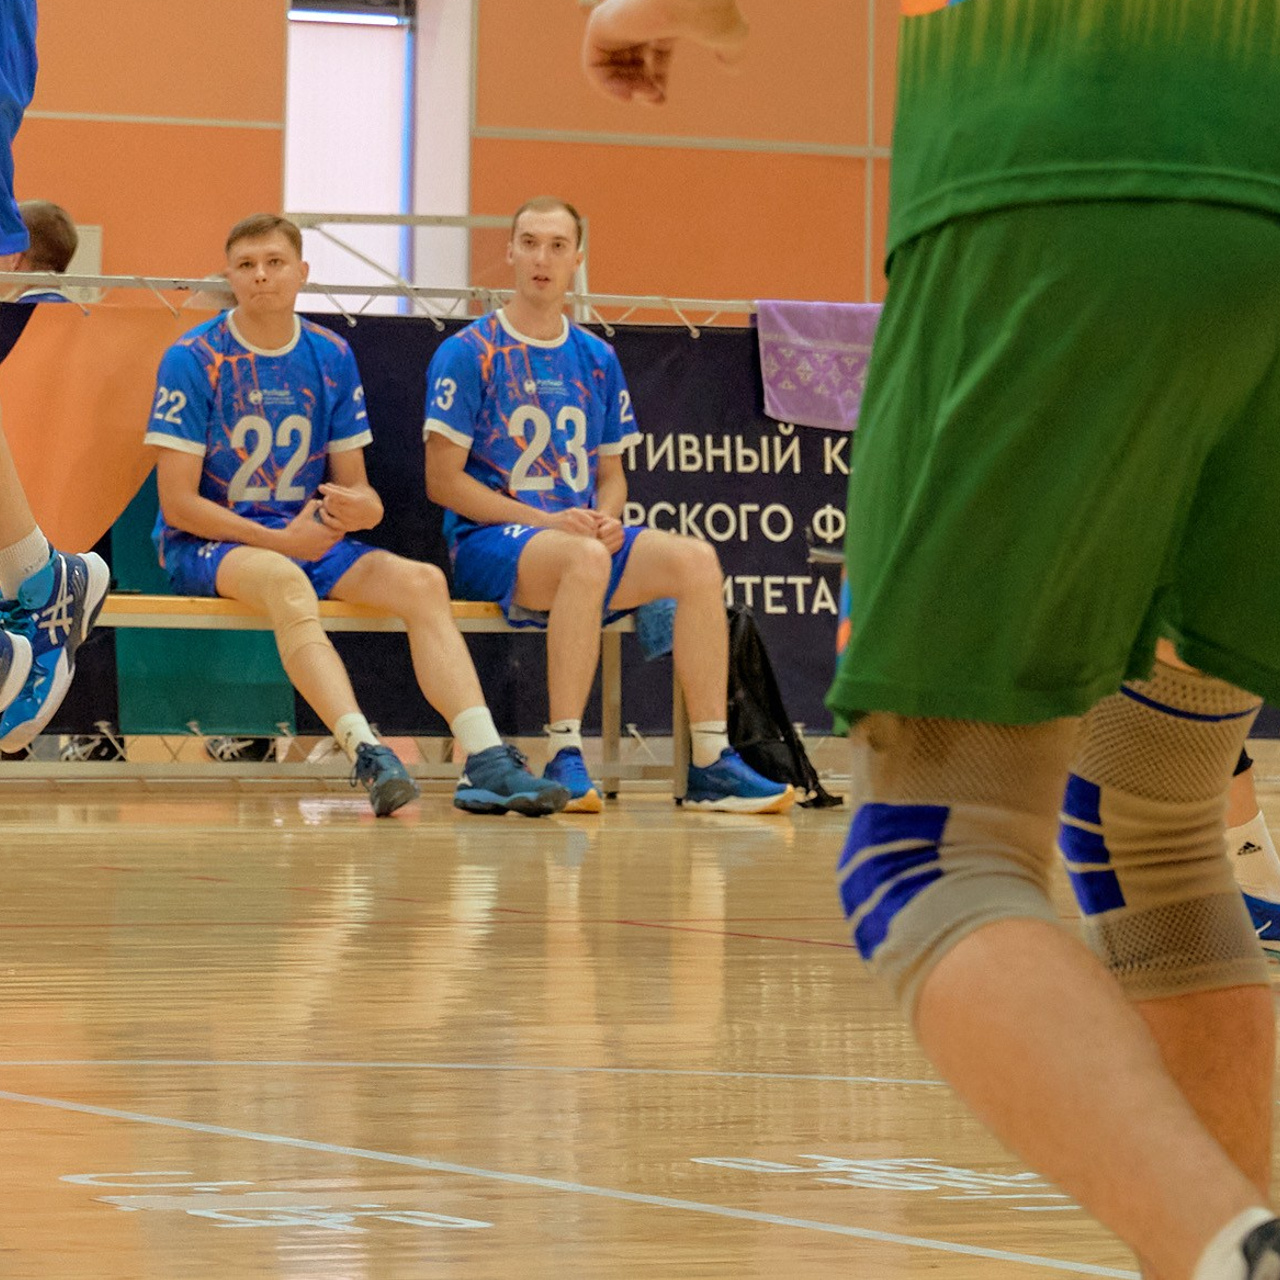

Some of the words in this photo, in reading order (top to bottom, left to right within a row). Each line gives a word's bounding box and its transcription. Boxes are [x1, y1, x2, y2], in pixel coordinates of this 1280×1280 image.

[153, 386, 187, 425] 22
[507, 404, 590, 494] 23
[227, 414, 313, 502] 22
